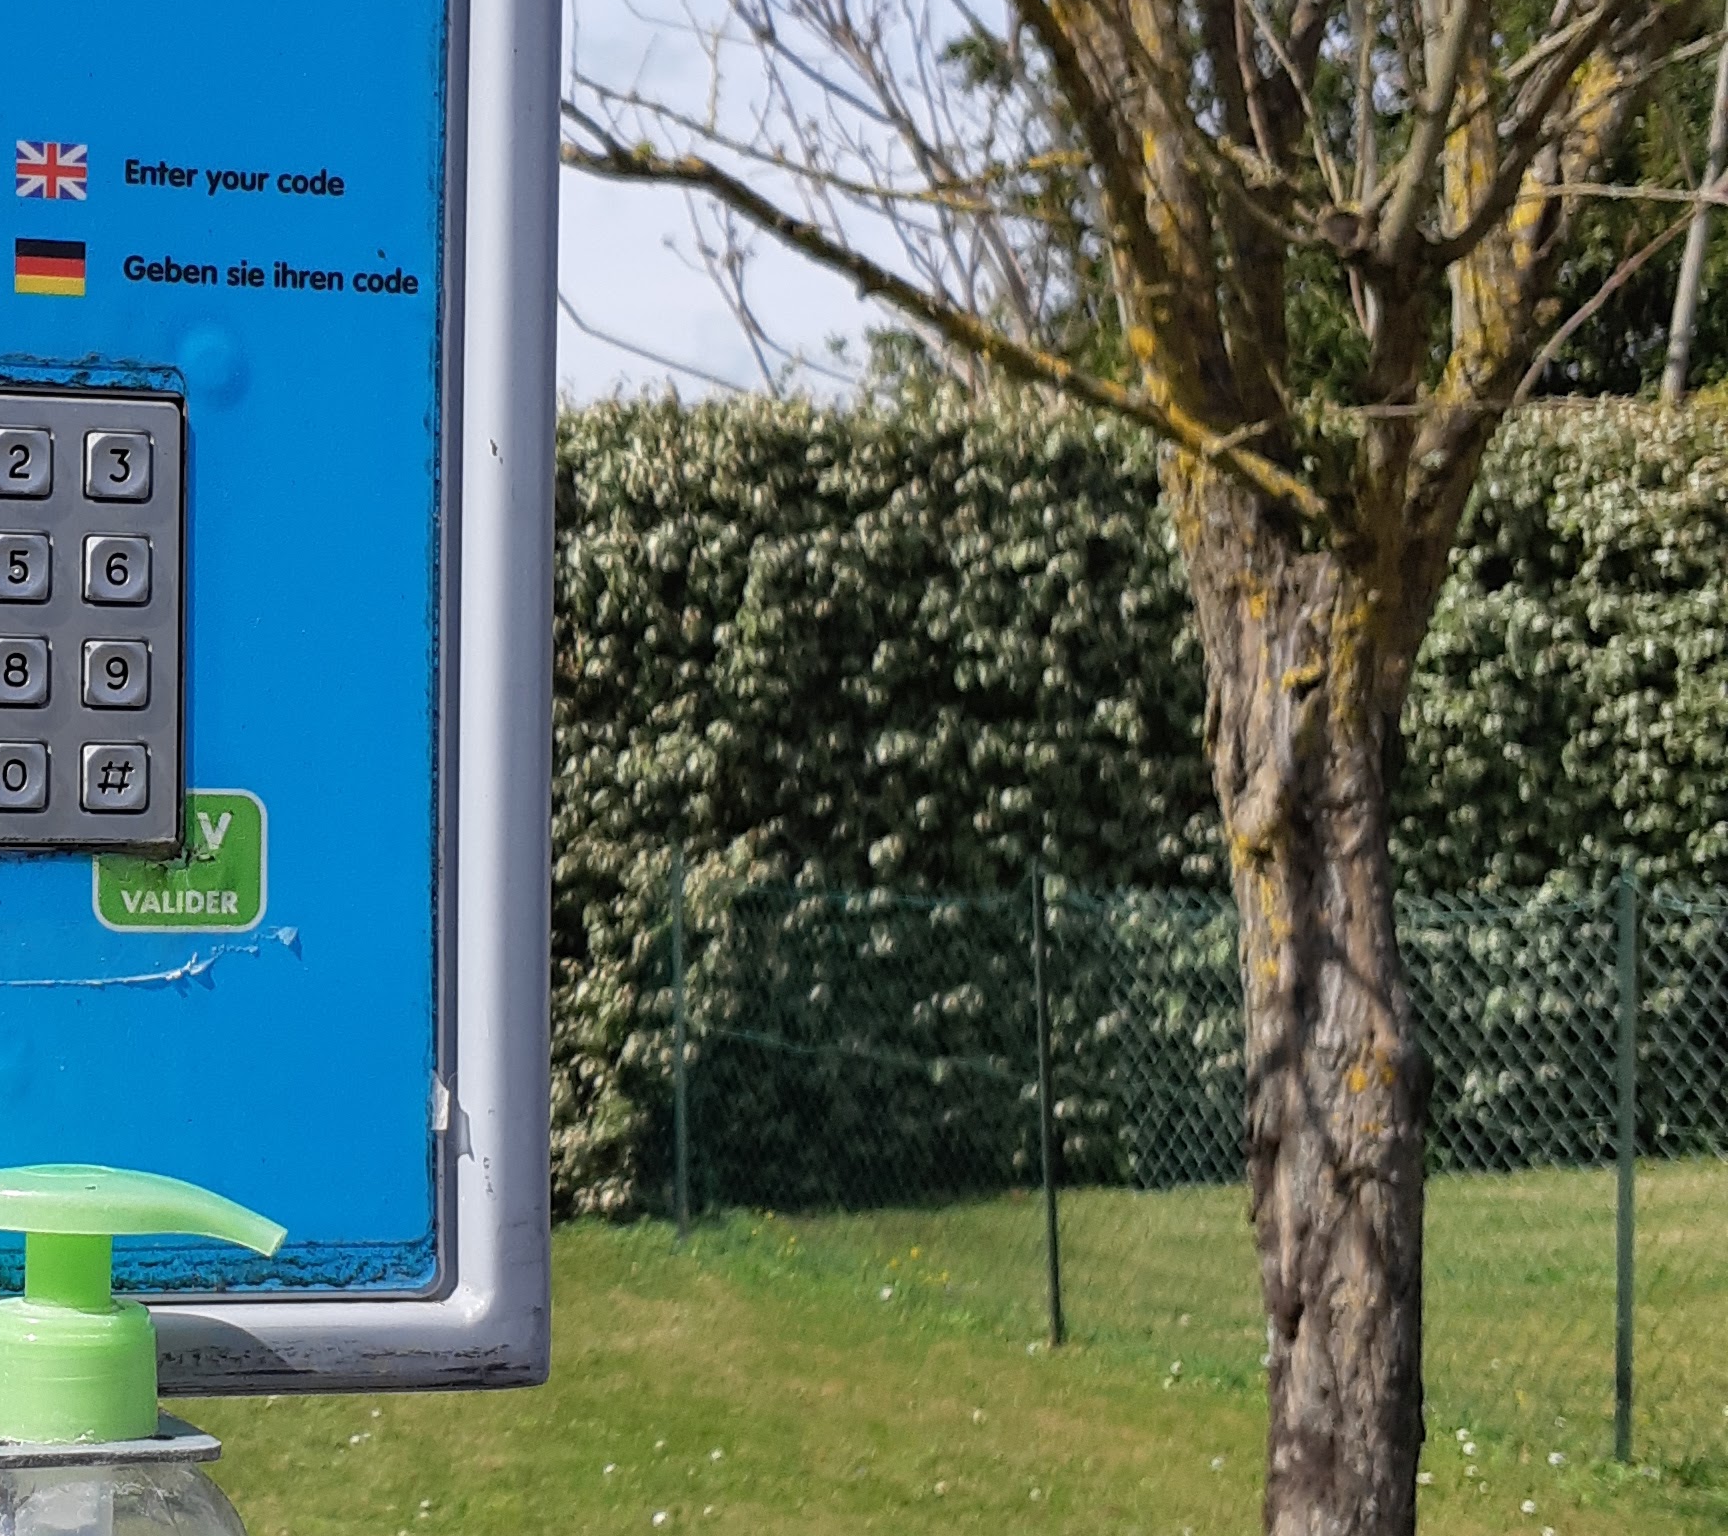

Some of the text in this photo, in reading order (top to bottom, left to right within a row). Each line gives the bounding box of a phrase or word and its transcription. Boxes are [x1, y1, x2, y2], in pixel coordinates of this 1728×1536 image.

[124, 159, 345, 199] Enter your code
[123, 257, 420, 296] Geben sie ihren code
[9, 445, 31, 480] 2
[110, 448, 131, 483] 3
[7, 550, 30, 585] 5
[106, 552, 129, 586] 6
[4, 652, 28, 687] 8
[106, 656, 129, 690] 9
[197, 811, 233, 851] V
[121, 889, 239, 916] VALIDER
